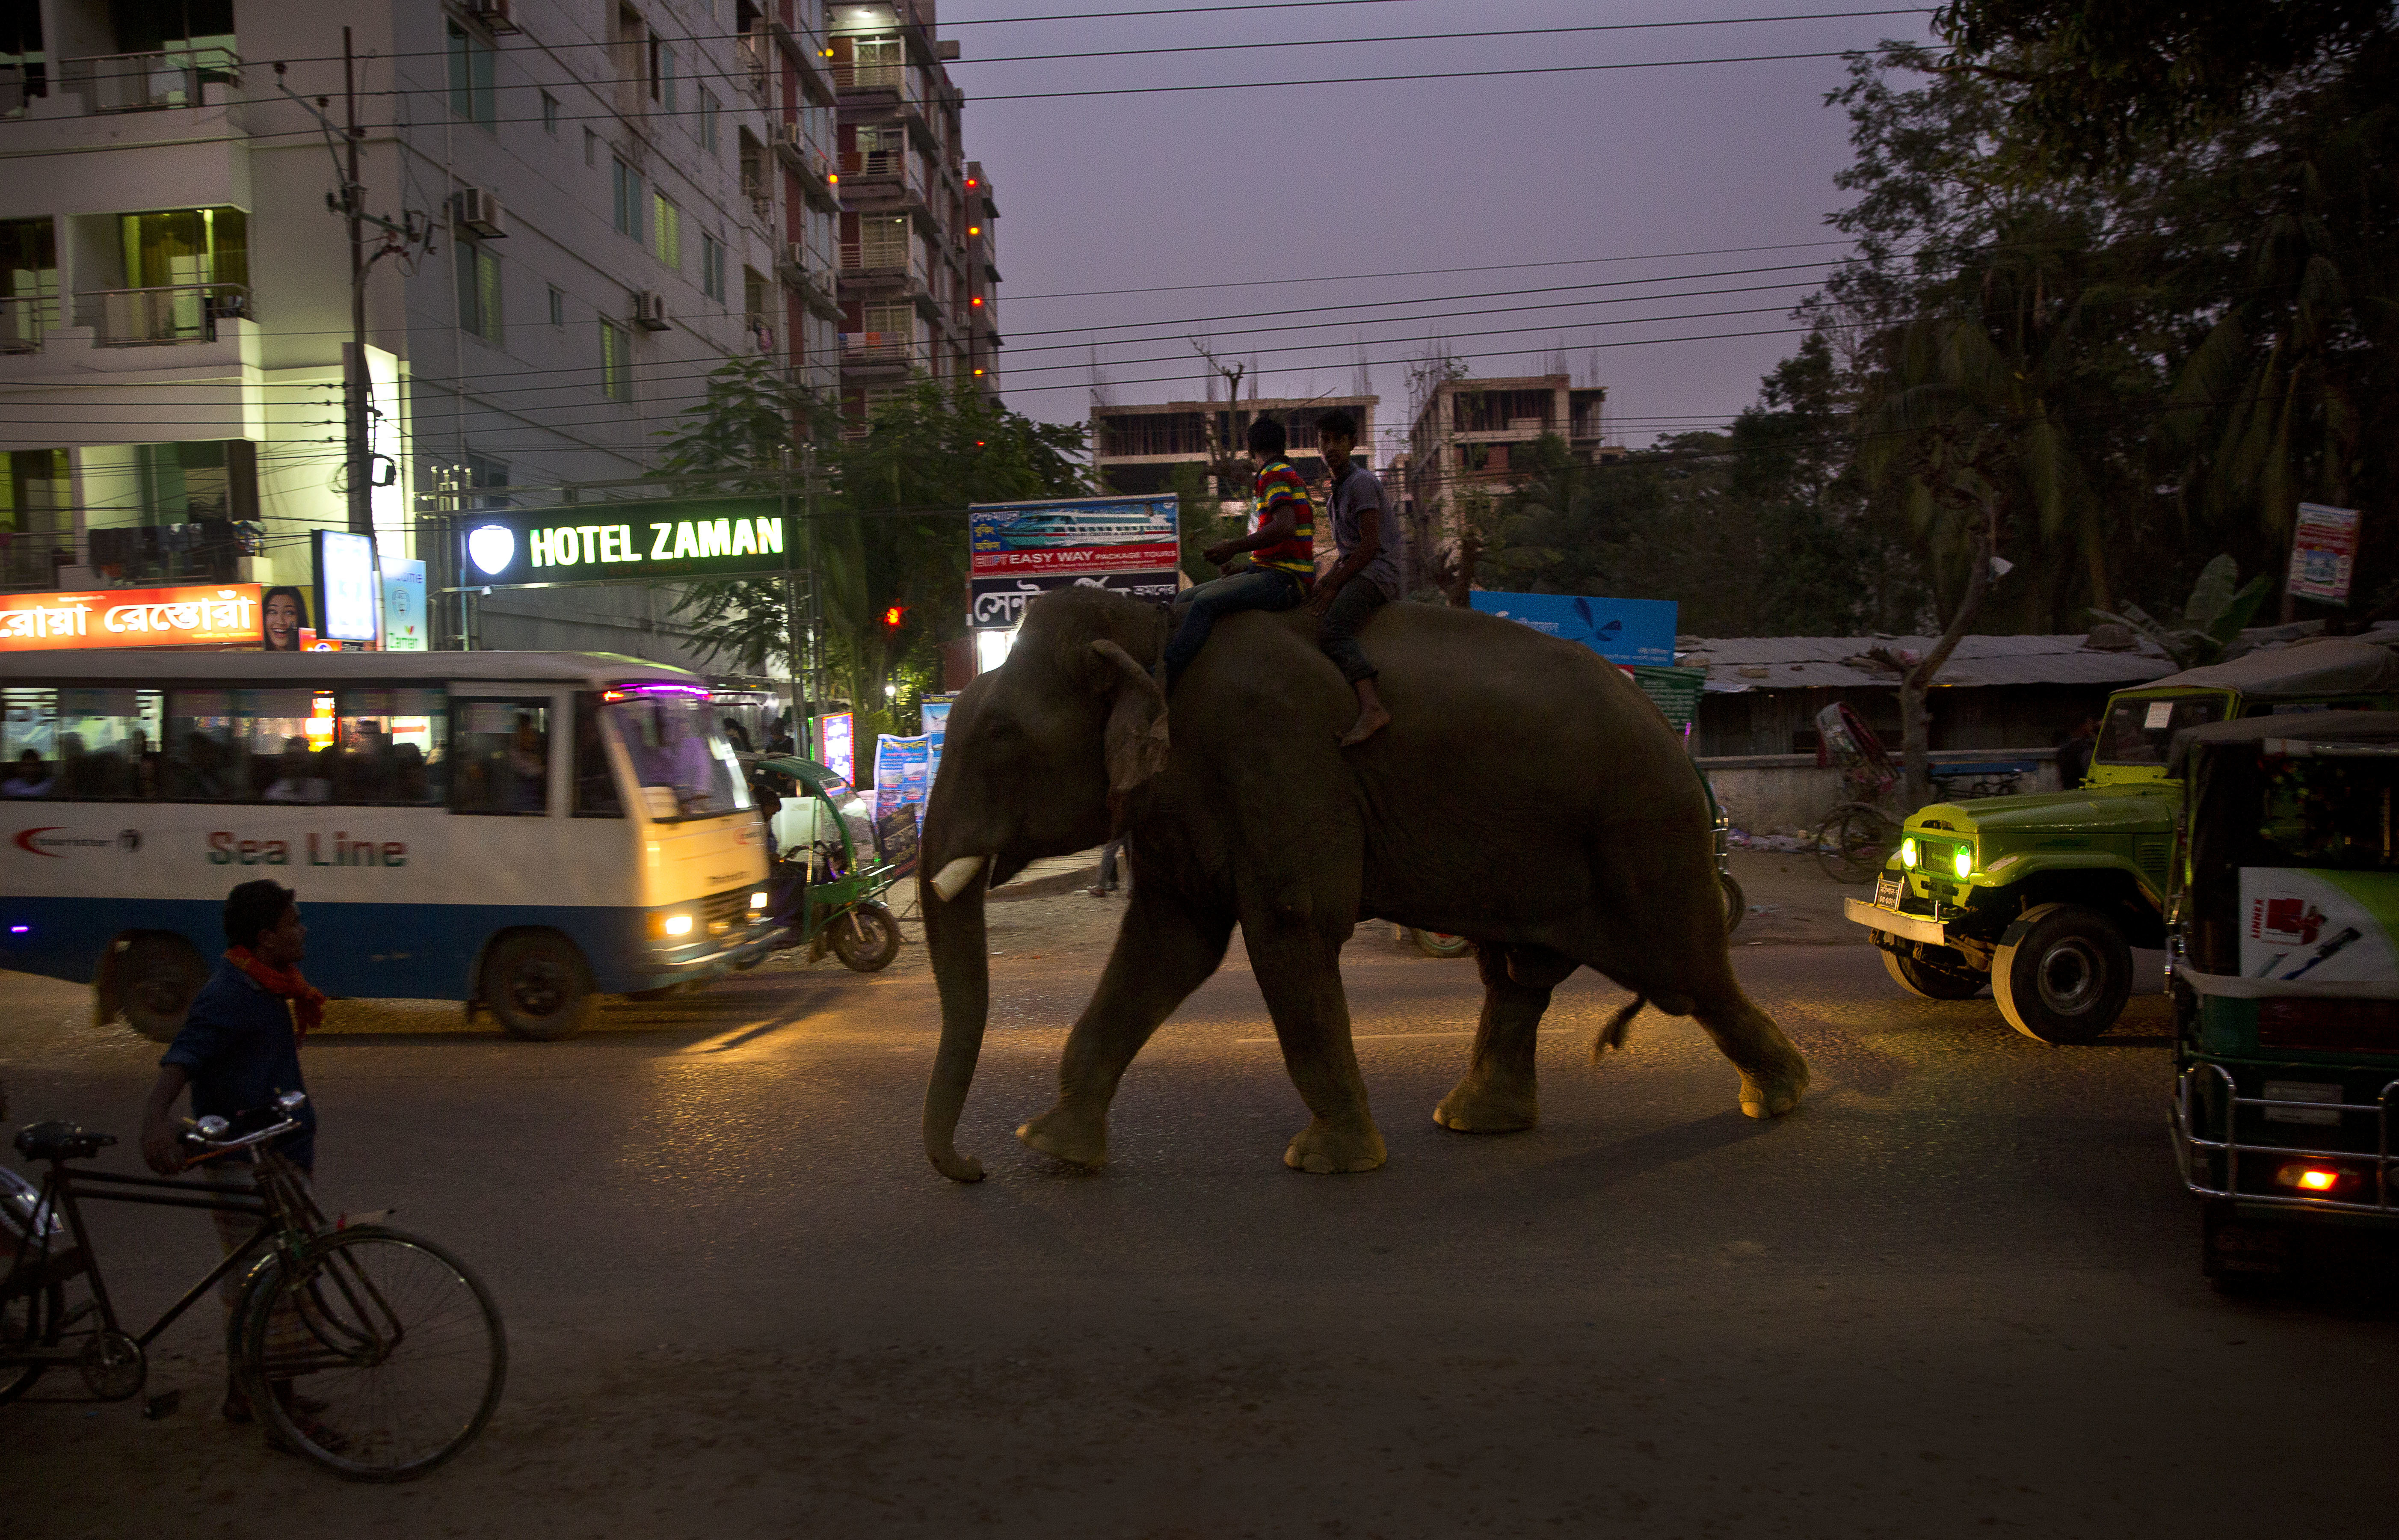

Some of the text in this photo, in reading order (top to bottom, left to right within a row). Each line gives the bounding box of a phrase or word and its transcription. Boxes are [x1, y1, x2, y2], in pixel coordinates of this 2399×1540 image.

[530, 516, 783, 567] HOTEL ZAMAN
[1010, 553, 1054, 565] EASY
[1057, 551, 1094, 562] WAY
[104, 589, 257, 634] রেস্তোরাঁ
[207, 831, 408, 866] Sea Line
[2251, 898, 2264, 939] LINNEX
